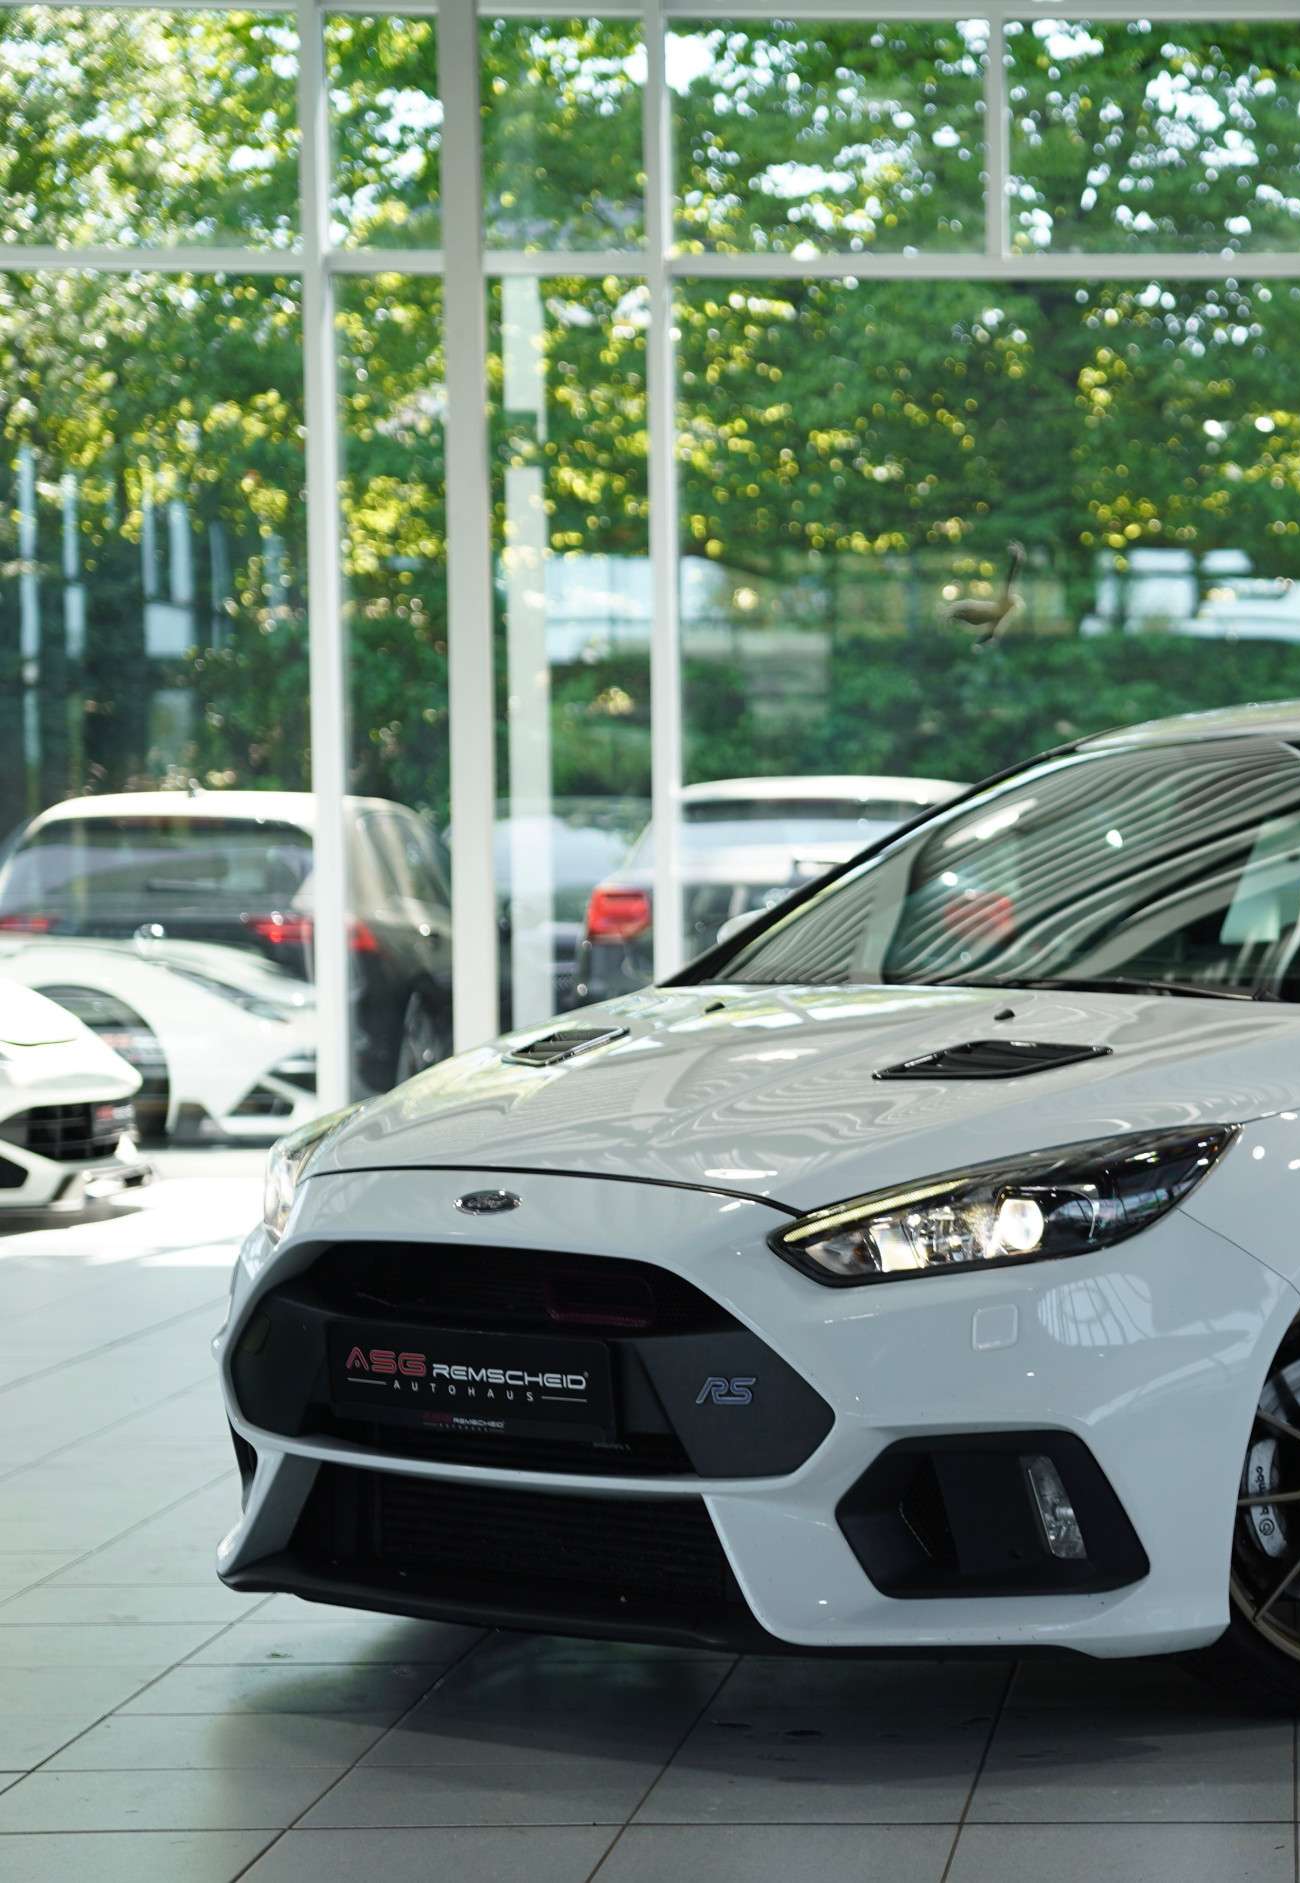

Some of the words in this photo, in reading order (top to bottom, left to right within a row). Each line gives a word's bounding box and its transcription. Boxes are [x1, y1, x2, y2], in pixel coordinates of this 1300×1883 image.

[346, 1346, 427, 1377] ASG
[432, 1363, 587, 1390] REMSCHEID
[393, 1380, 534, 1402] AUTOHAUS
[696, 1377, 756, 1404] RS
